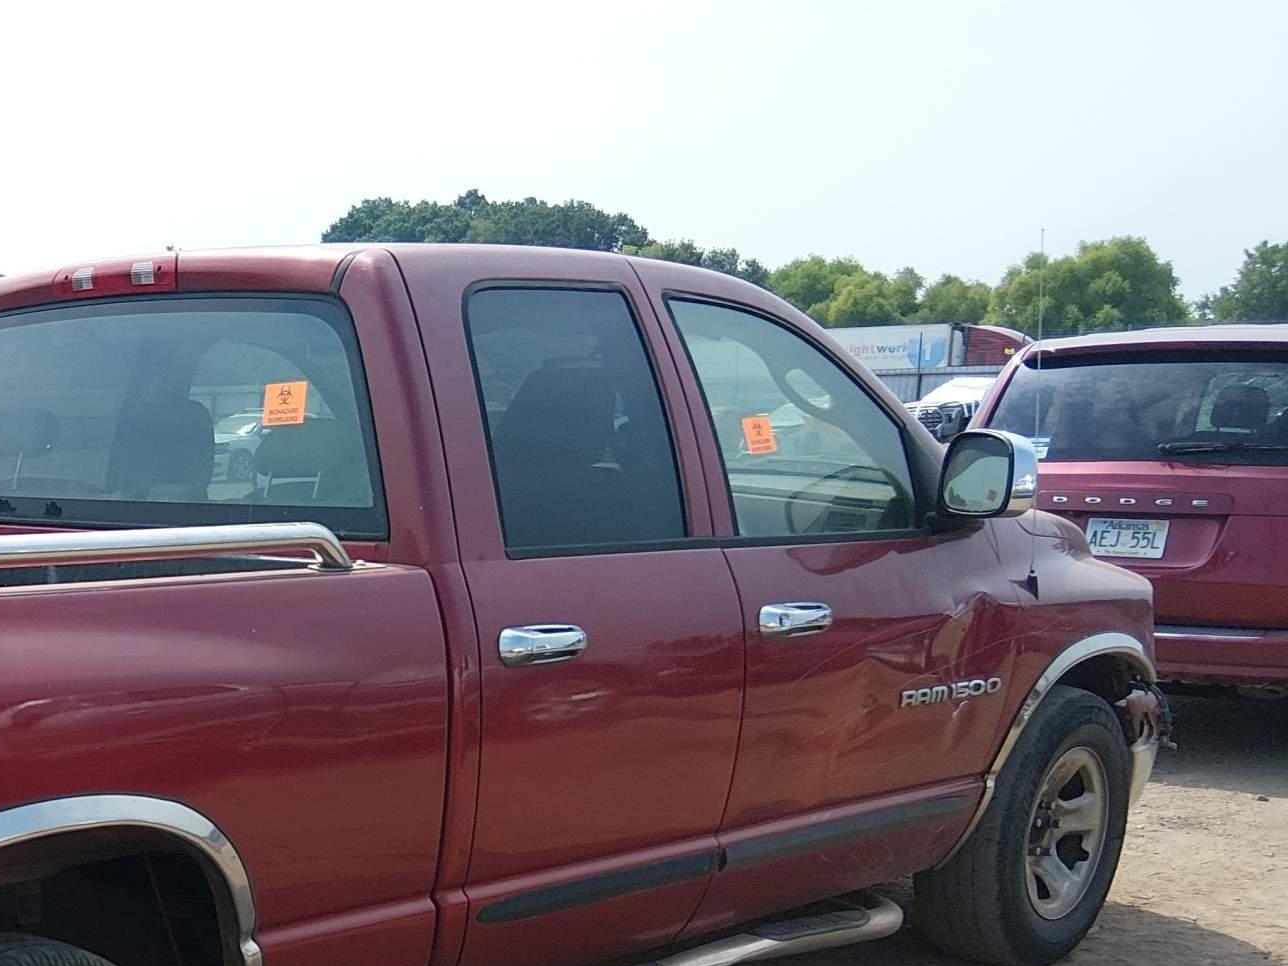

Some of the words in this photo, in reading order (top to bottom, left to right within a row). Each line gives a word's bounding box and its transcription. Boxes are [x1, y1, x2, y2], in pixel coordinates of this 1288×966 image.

[1052, 495, 1209, 507] DODGE
[1089, 529, 1121, 548] AEJ
[1129, 531, 1161, 550] 55L
[899, 685, 948, 708] RAM
[951, 677, 1002, 700] 1500
